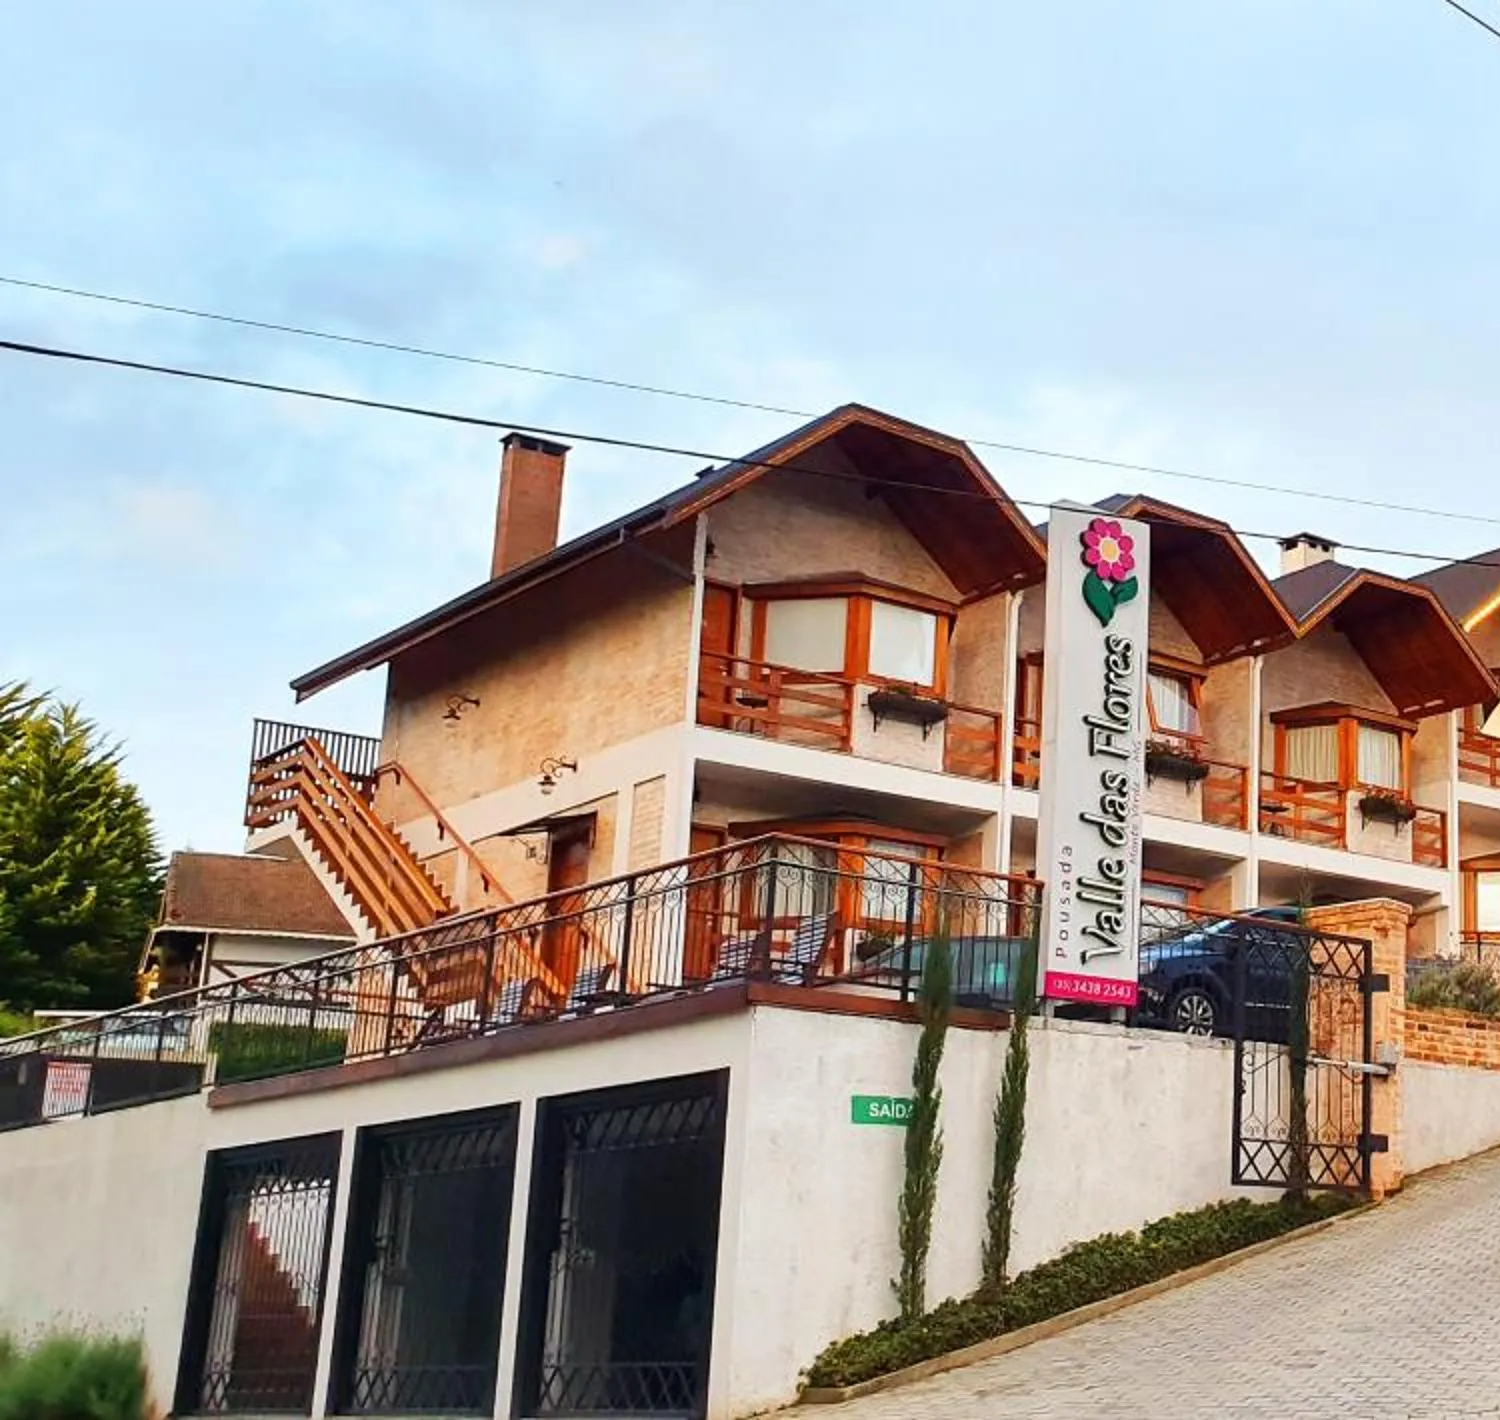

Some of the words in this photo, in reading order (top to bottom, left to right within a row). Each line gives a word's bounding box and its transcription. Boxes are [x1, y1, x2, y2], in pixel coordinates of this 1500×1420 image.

[1083, 634, 1134, 760] Flores
[1079, 771, 1130, 848] das
[1056, 846, 1073, 958] Pousada
[1077, 856, 1127, 965] Valle
